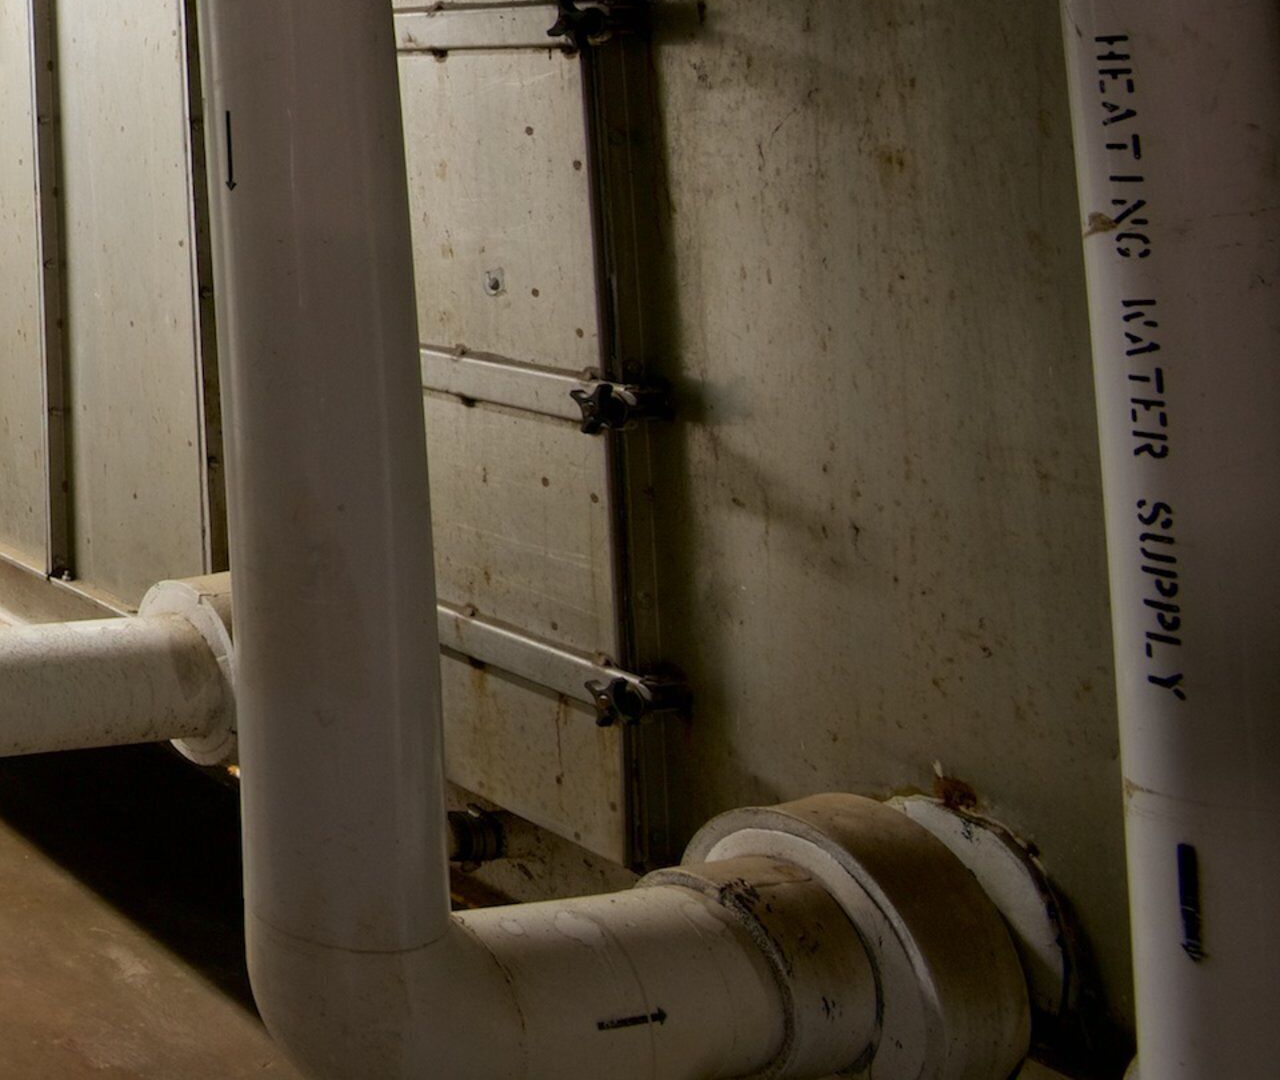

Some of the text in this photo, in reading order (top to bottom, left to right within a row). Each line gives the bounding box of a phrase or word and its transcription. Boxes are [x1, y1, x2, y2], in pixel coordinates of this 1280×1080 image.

[1094, 35, 1187, 701] HEATING WATER SUPPLY
